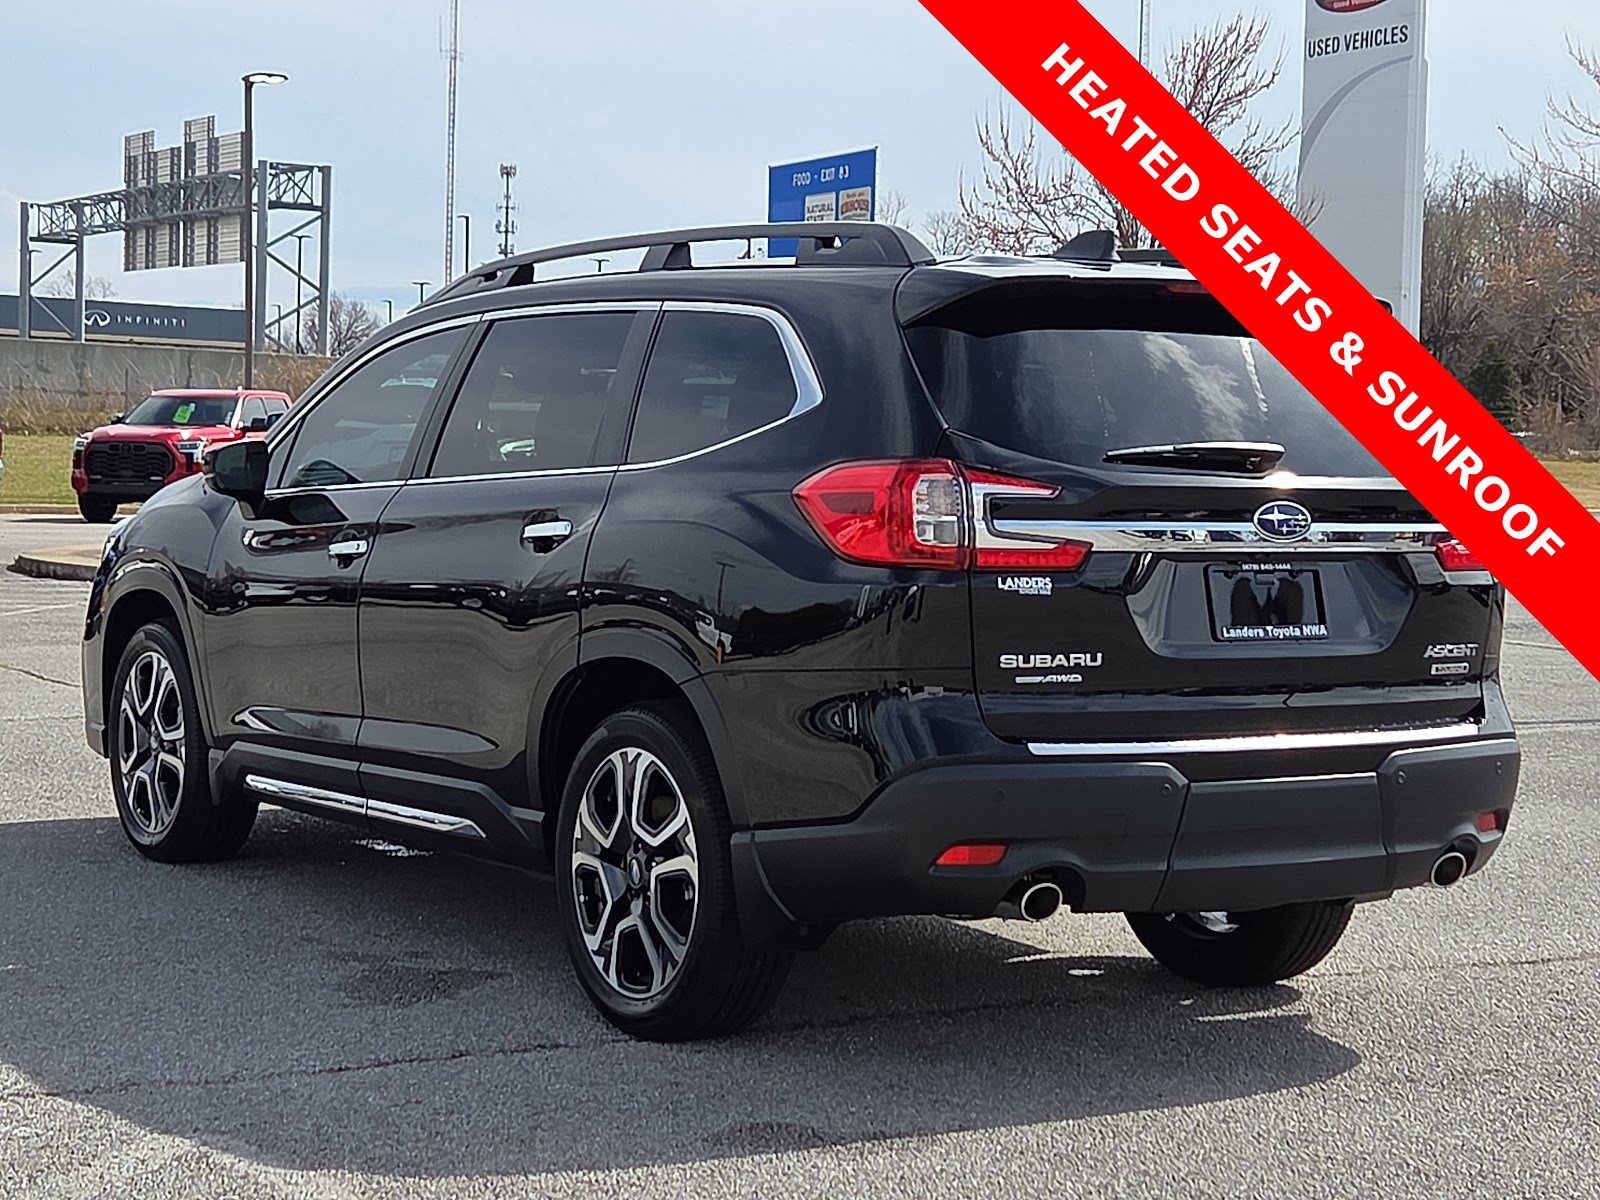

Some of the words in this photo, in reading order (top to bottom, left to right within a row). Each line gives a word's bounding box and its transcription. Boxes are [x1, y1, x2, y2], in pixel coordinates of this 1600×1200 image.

[1308, 36, 1340, 58] USED
[1344, 24, 1409, 52] VEHICLES
[792, 172, 811, 187] FOOD
[820, 167, 836, 182] EXIT
[116, 314, 187, 328] INFINITI
[997, 576, 1052, 590] LANDERS
[1223, 626, 1264, 638] Landers
[1266, 625, 1301, 639] Toyota
[1302, 624, 1328, 636] NWA
[1423, 643, 1479, 658] ASCENT
[1000, 652, 1103, 668] SUBARU
[1042, 673, 1083, 683] AWD
